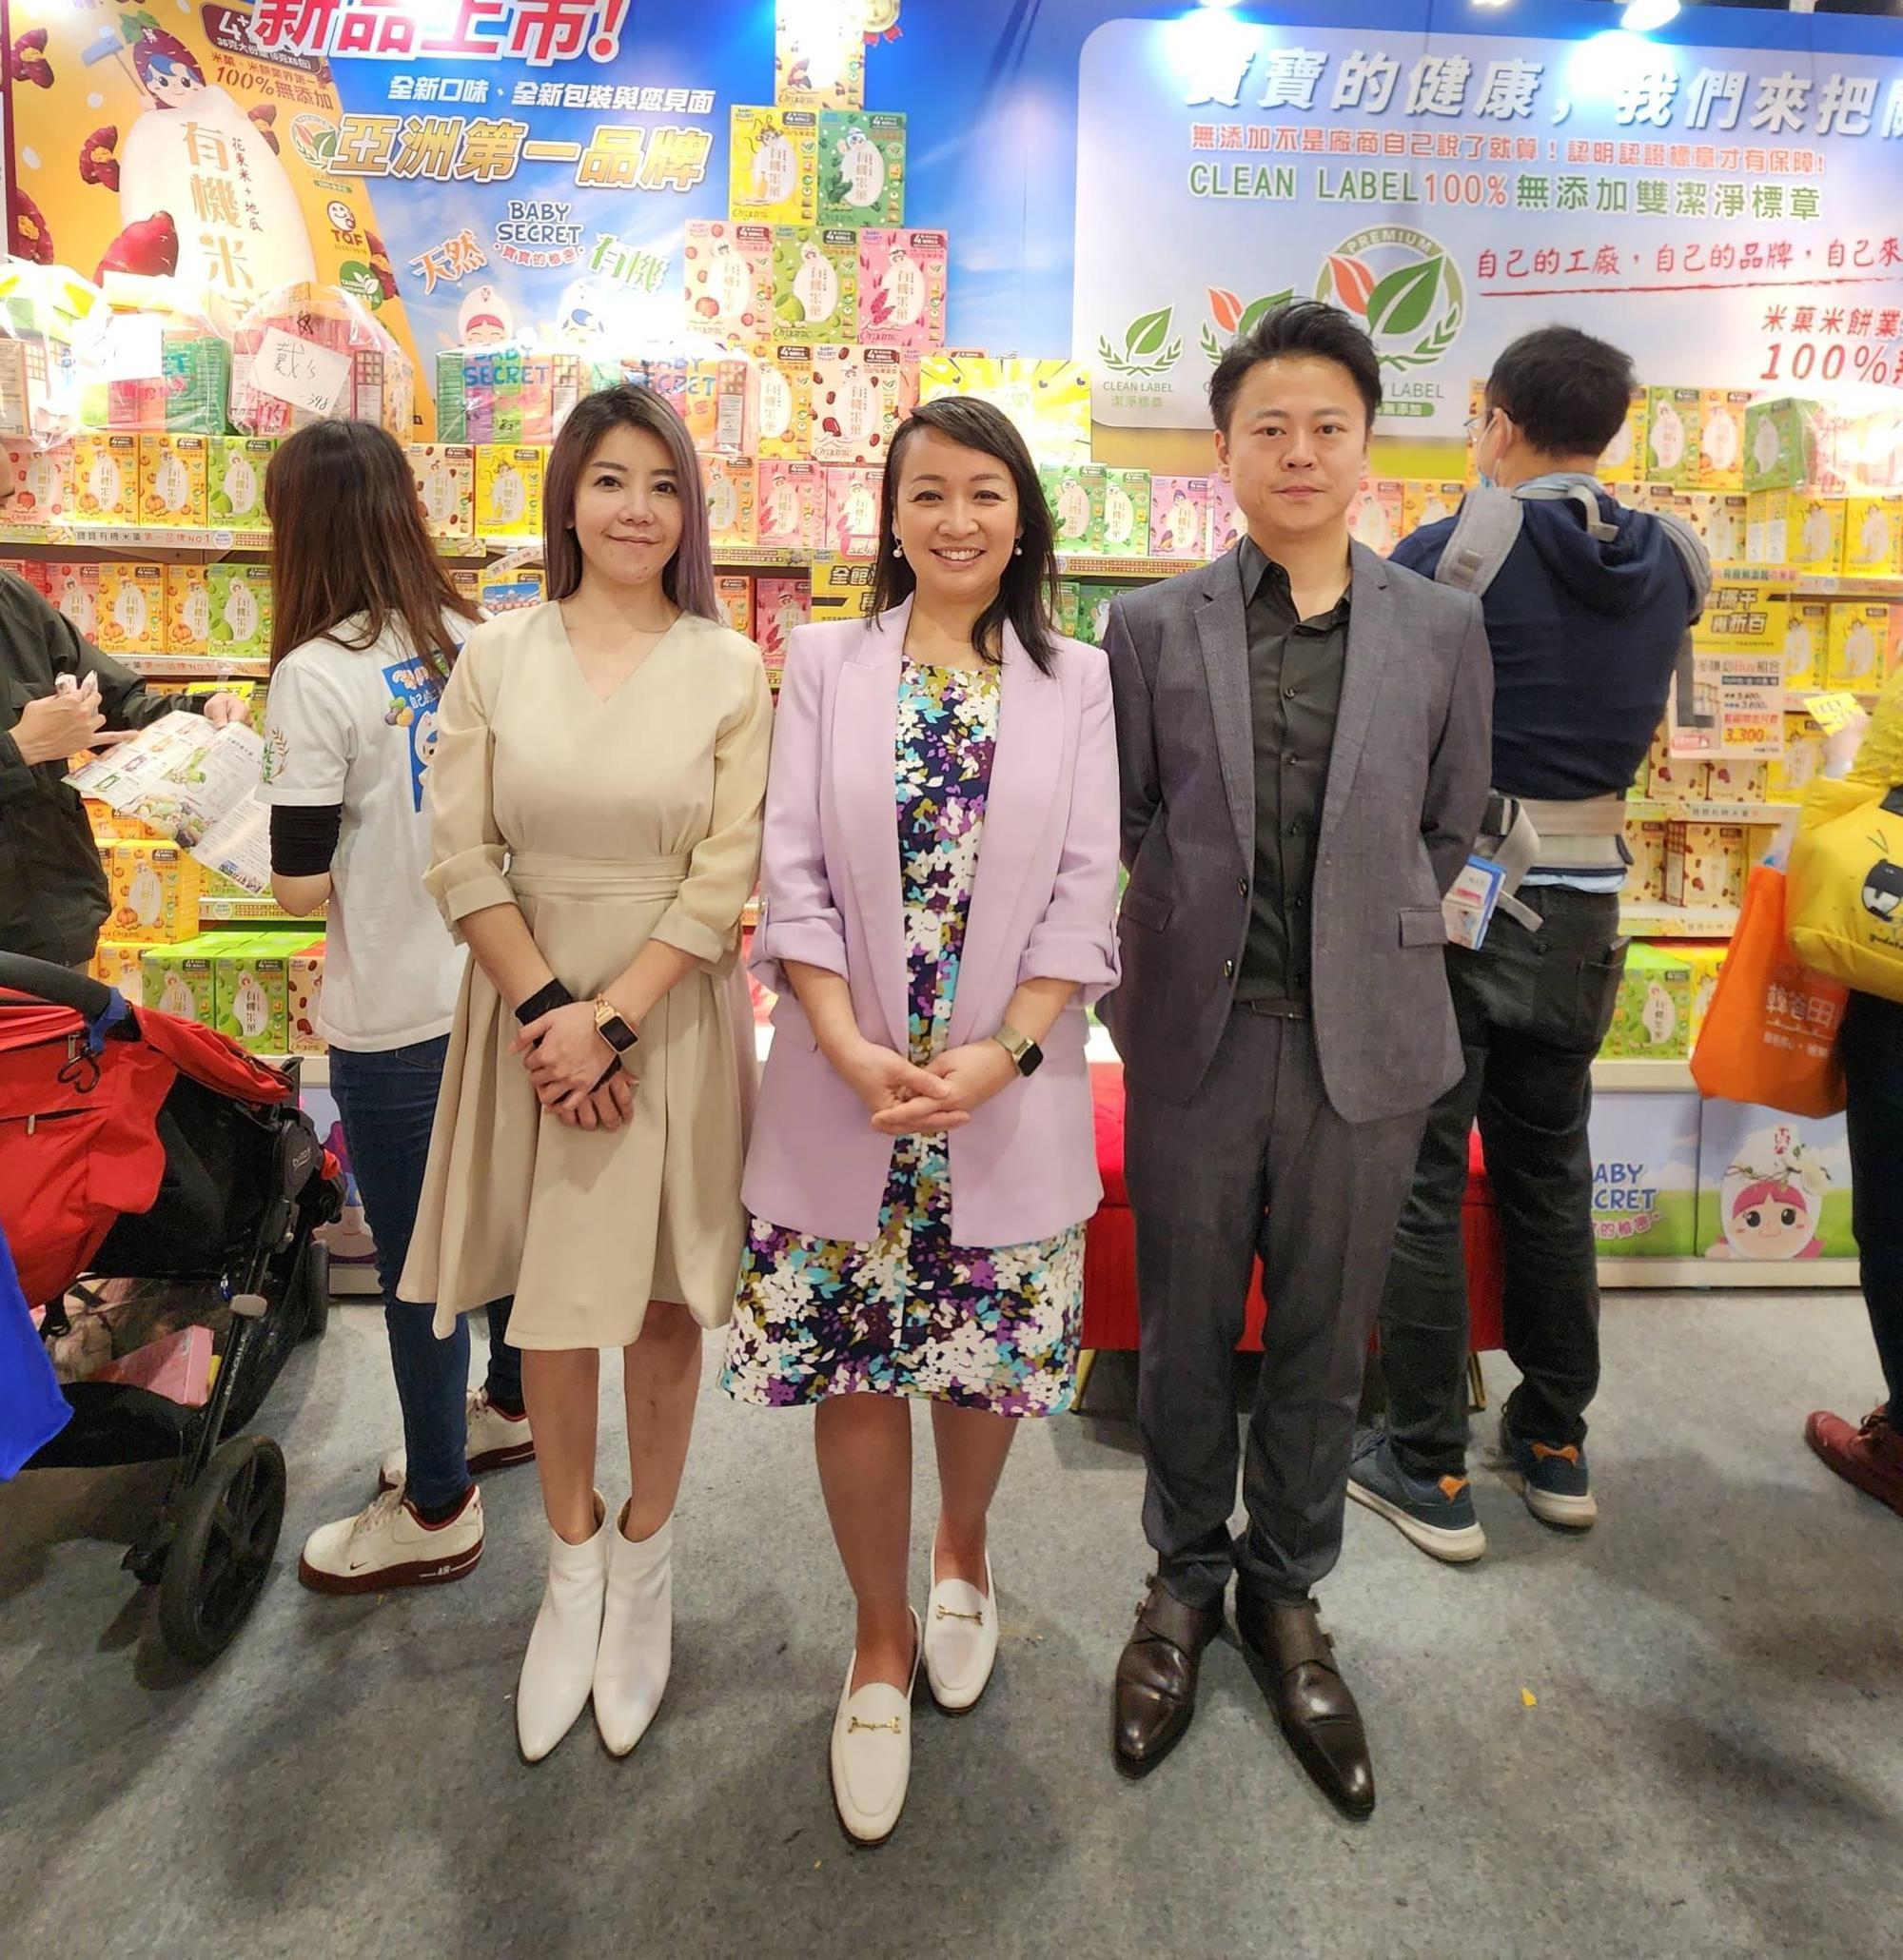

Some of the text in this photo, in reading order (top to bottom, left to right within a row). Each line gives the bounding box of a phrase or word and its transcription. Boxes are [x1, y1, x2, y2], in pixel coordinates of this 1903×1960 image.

[253, 0, 625, 62] 新品上市!
[387, 75, 716, 114] 全新口味、全新包裝與您見面
[330, 115, 713, 190] 亞洲第一品牌
[1190, 165, 1295, 198] CLEAN
[510, 202, 569, 222] BABY
[498, 223, 581, 245] SECRET
[1346, 227, 1434, 255] PREMIUM
[409, 229, 487, 295] 天然
[591, 234, 670, 293] 有機
[461, 365, 549, 386] SECRET
[1760, 343, 1903, 384] 100%
[1103, 381, 1174, 393] CLEAN LABEL
[1391, 382, 1445, 398] LABEL
[1592, 1163, 1644, 1184] ABY
[1591, 1188, 1657, 1210] CRET
